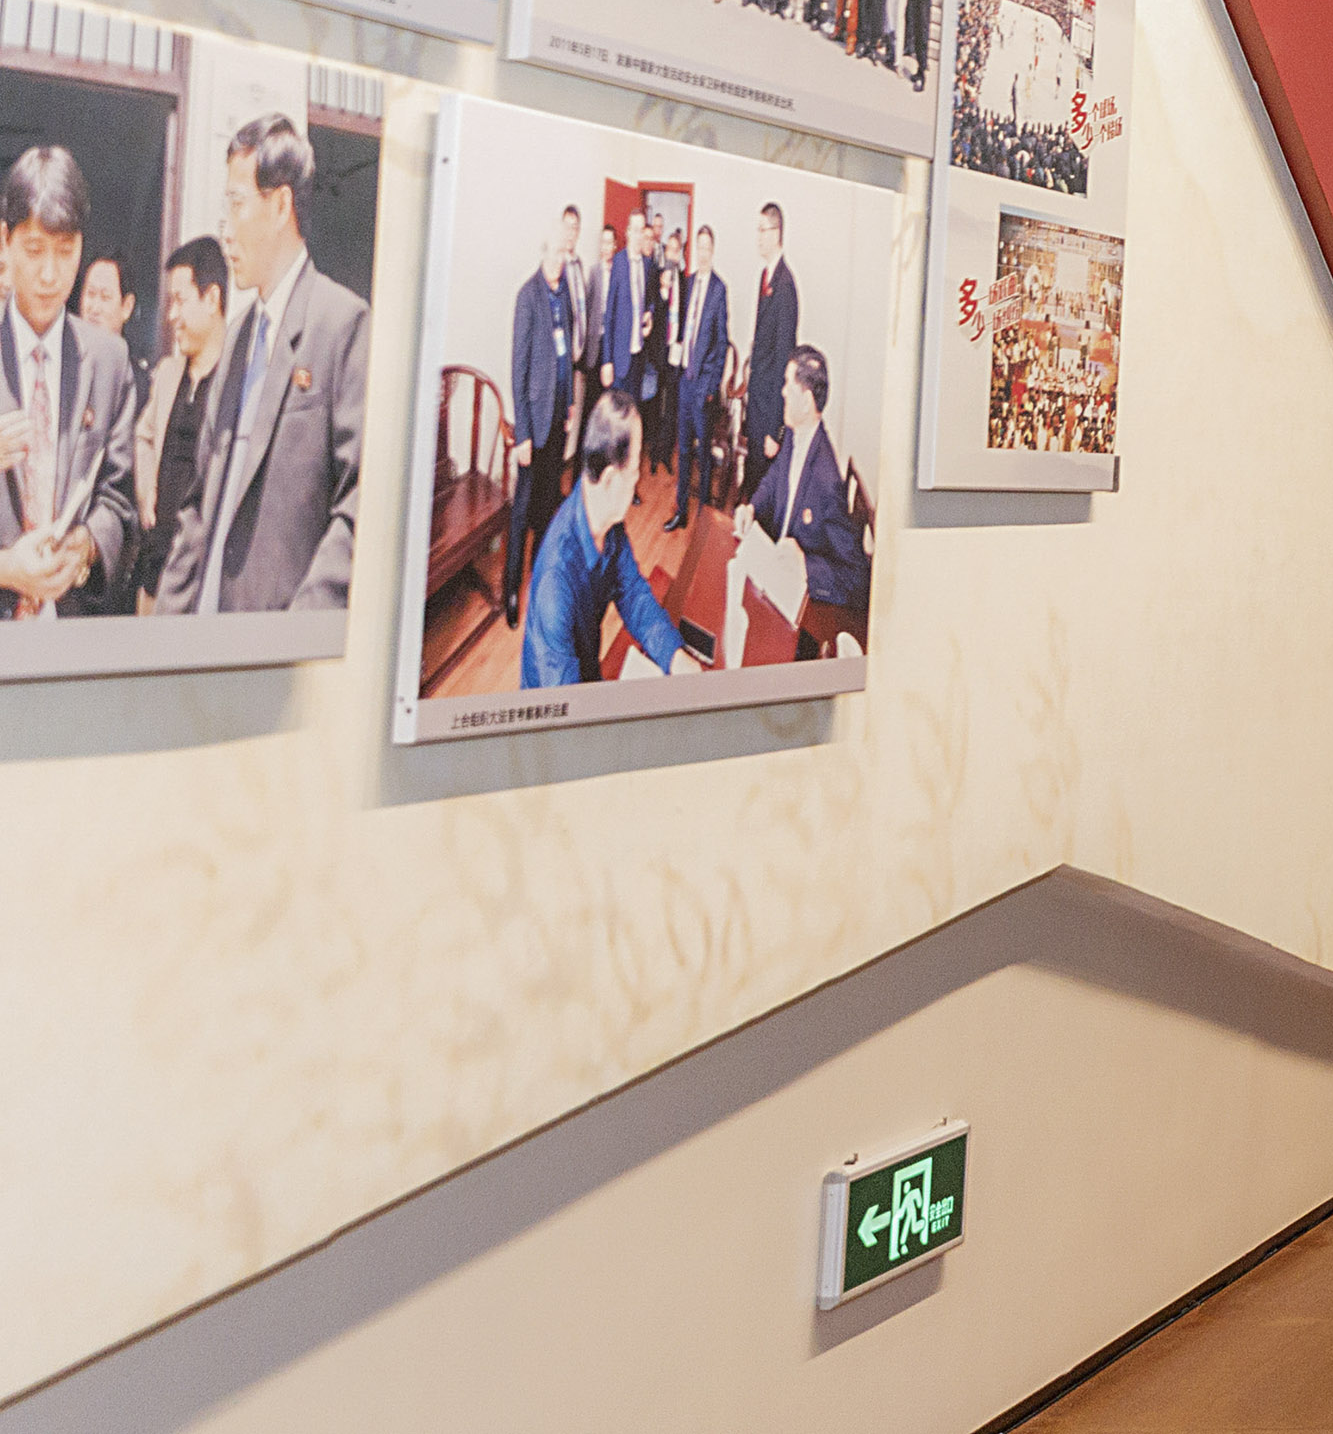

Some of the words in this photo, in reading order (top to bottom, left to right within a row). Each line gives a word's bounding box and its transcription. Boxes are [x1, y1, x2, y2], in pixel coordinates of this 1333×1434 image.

[929, 1195, 955, 1222] 安全出口
[930, 1215, 951, 1234] EXIT
